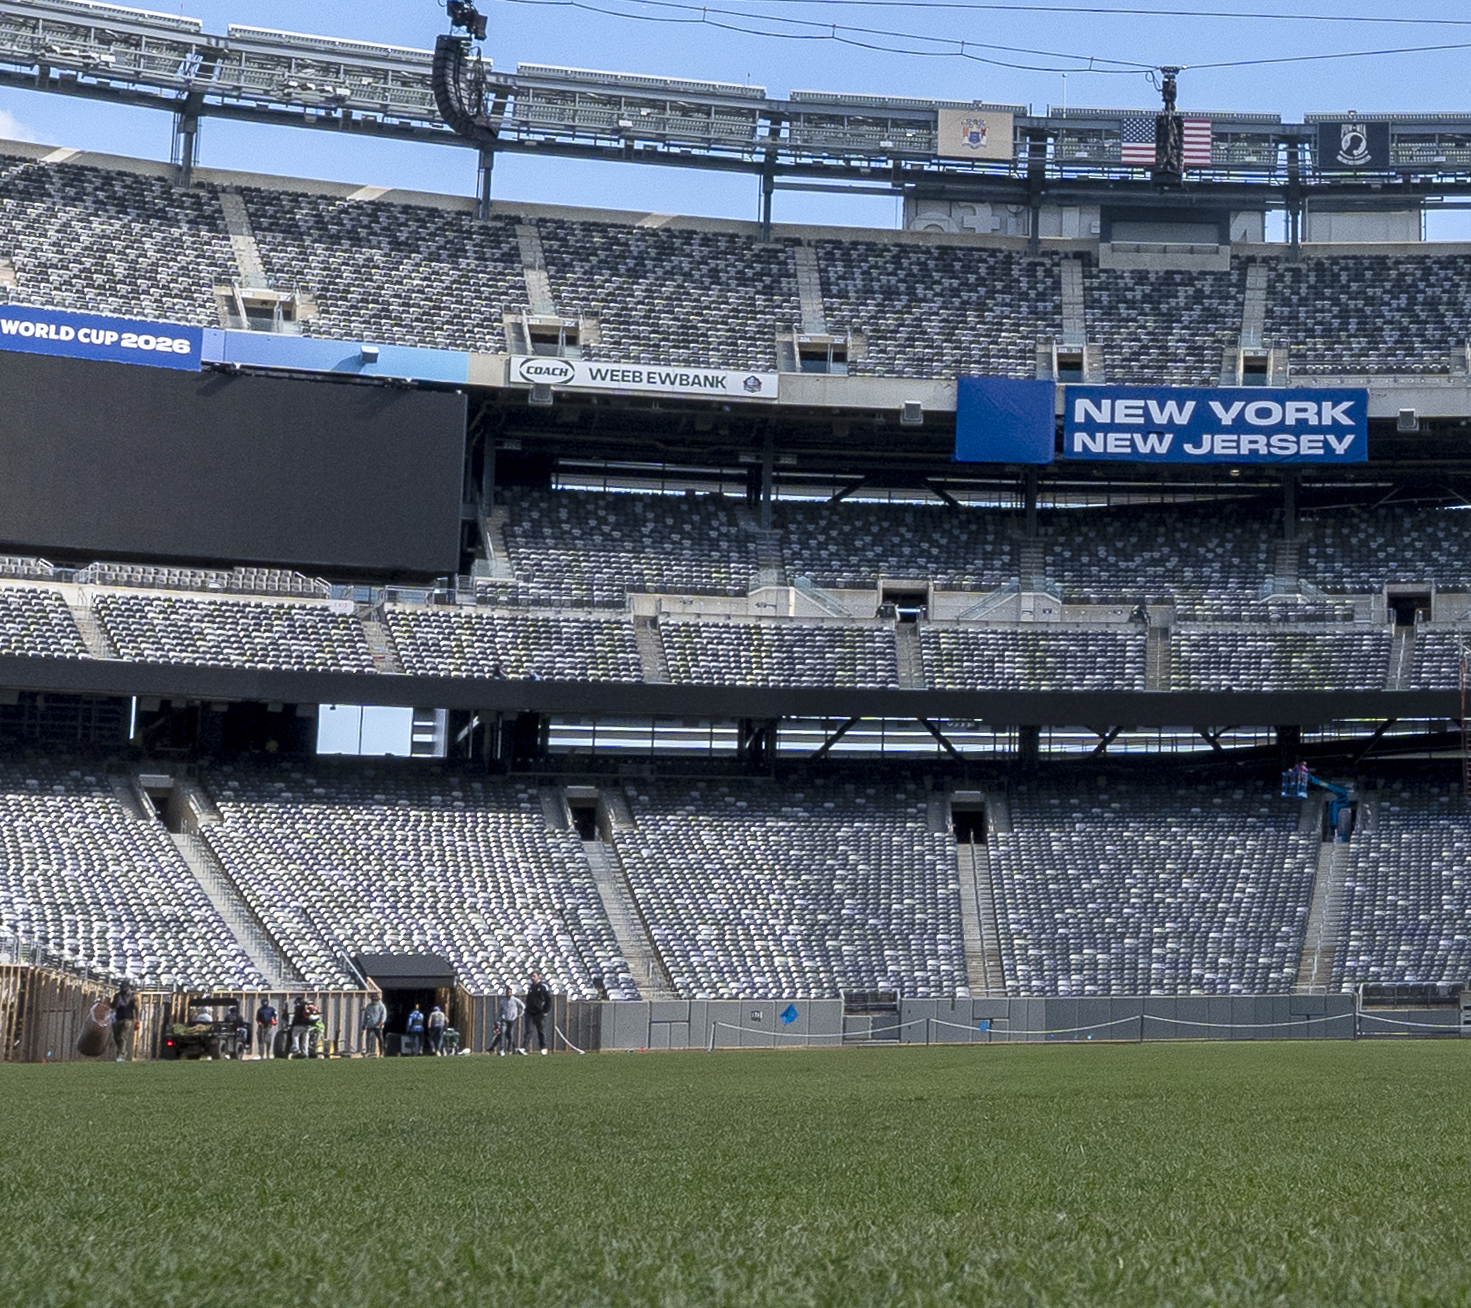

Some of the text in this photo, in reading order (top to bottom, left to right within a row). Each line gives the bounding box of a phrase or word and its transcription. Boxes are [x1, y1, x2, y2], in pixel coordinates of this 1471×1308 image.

[0, 319, 75, 341] WORLD
[78, 328, 118, 345] CUP
[121, 333, 191, 354] 2026
[526, 365, 569, 377] COACH
[589, 368, 726, 389] WEEB EWBANK
[1074, 399, 1356, 426] NEW YORK
[1074, 432, 1356, 455] NEW JERSEY
